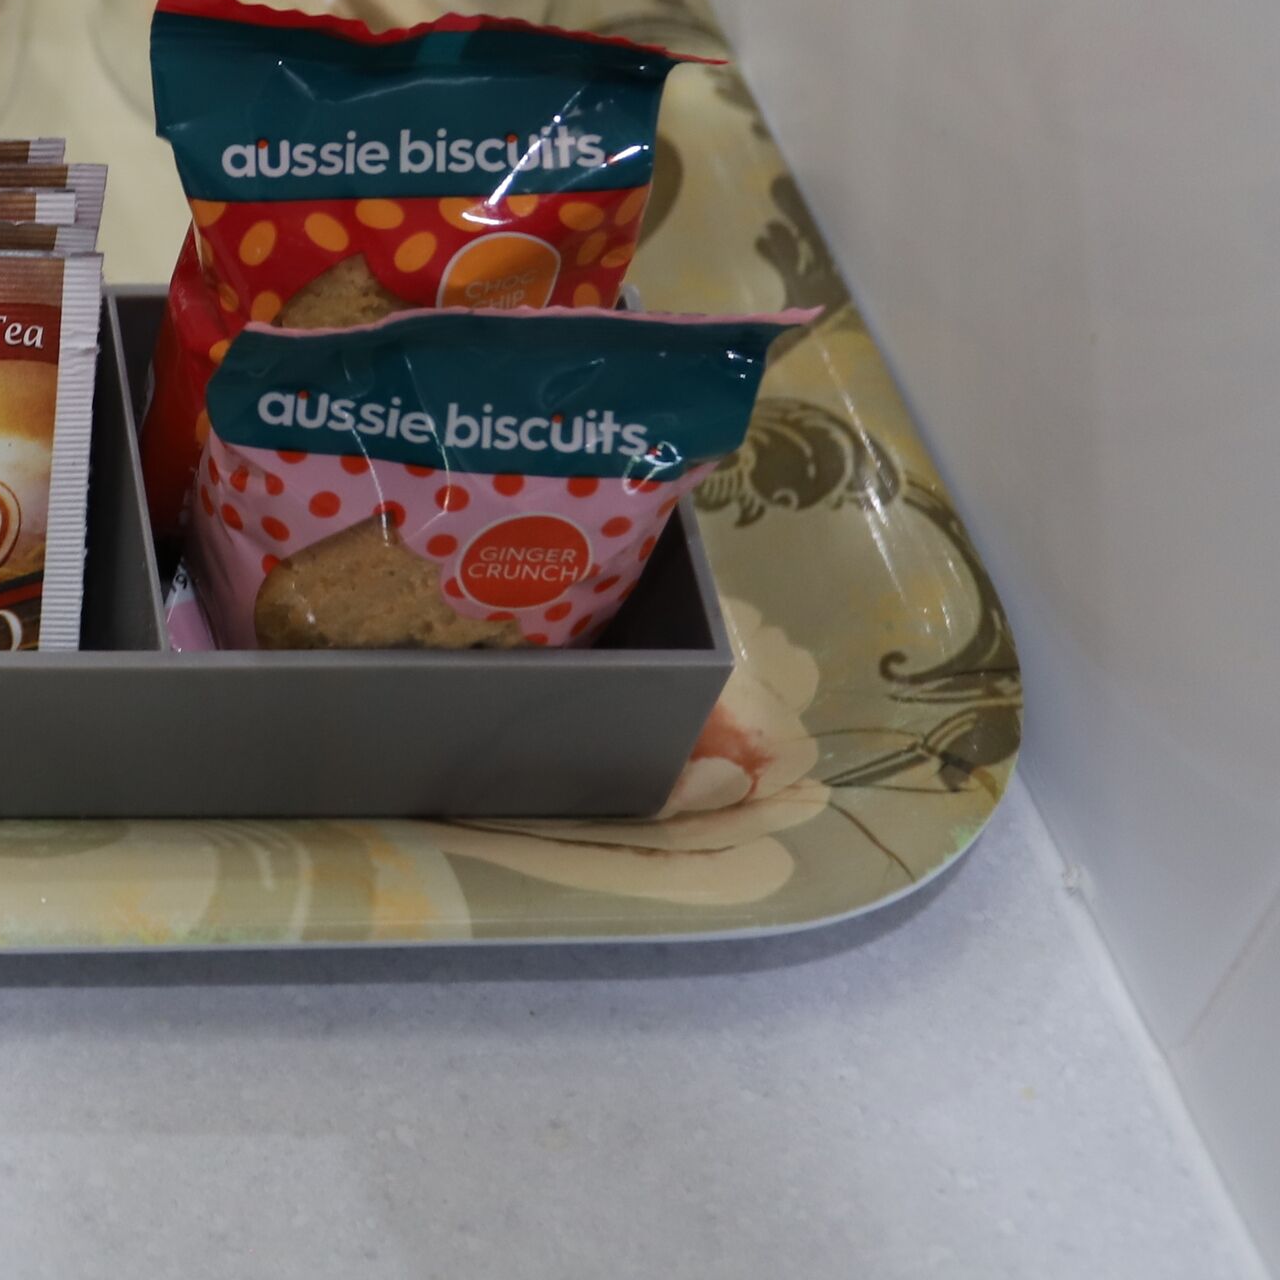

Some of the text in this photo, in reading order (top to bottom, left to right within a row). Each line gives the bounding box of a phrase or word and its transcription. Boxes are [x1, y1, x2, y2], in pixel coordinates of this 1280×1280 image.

[221, 131, 390, 178] aussie
[257, 391, 433, 444] aussie
[480, 546, 577, 564] GINGER
[468, 563, 579, 582] CRUNCH
